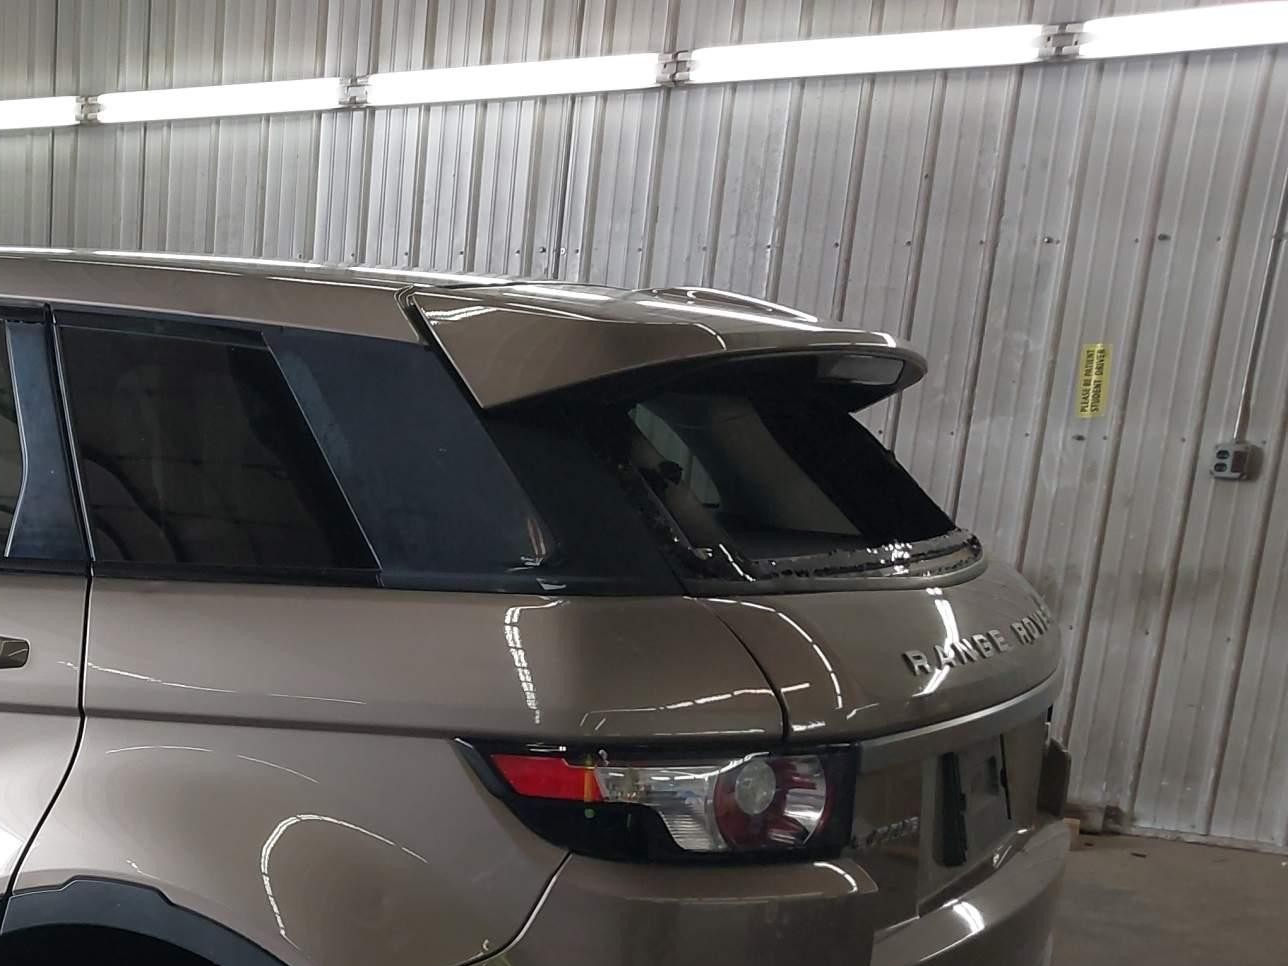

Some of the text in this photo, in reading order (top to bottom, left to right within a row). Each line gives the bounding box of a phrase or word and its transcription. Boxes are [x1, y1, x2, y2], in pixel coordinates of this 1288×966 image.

[1084, 350, 1094, 377] PATIENT
[1091, 349, 1105, 412] STUDENT DRIVER
[1080, 388, 1090, 412] PLEASE
[901, 629, 1010, 676] RANGE
